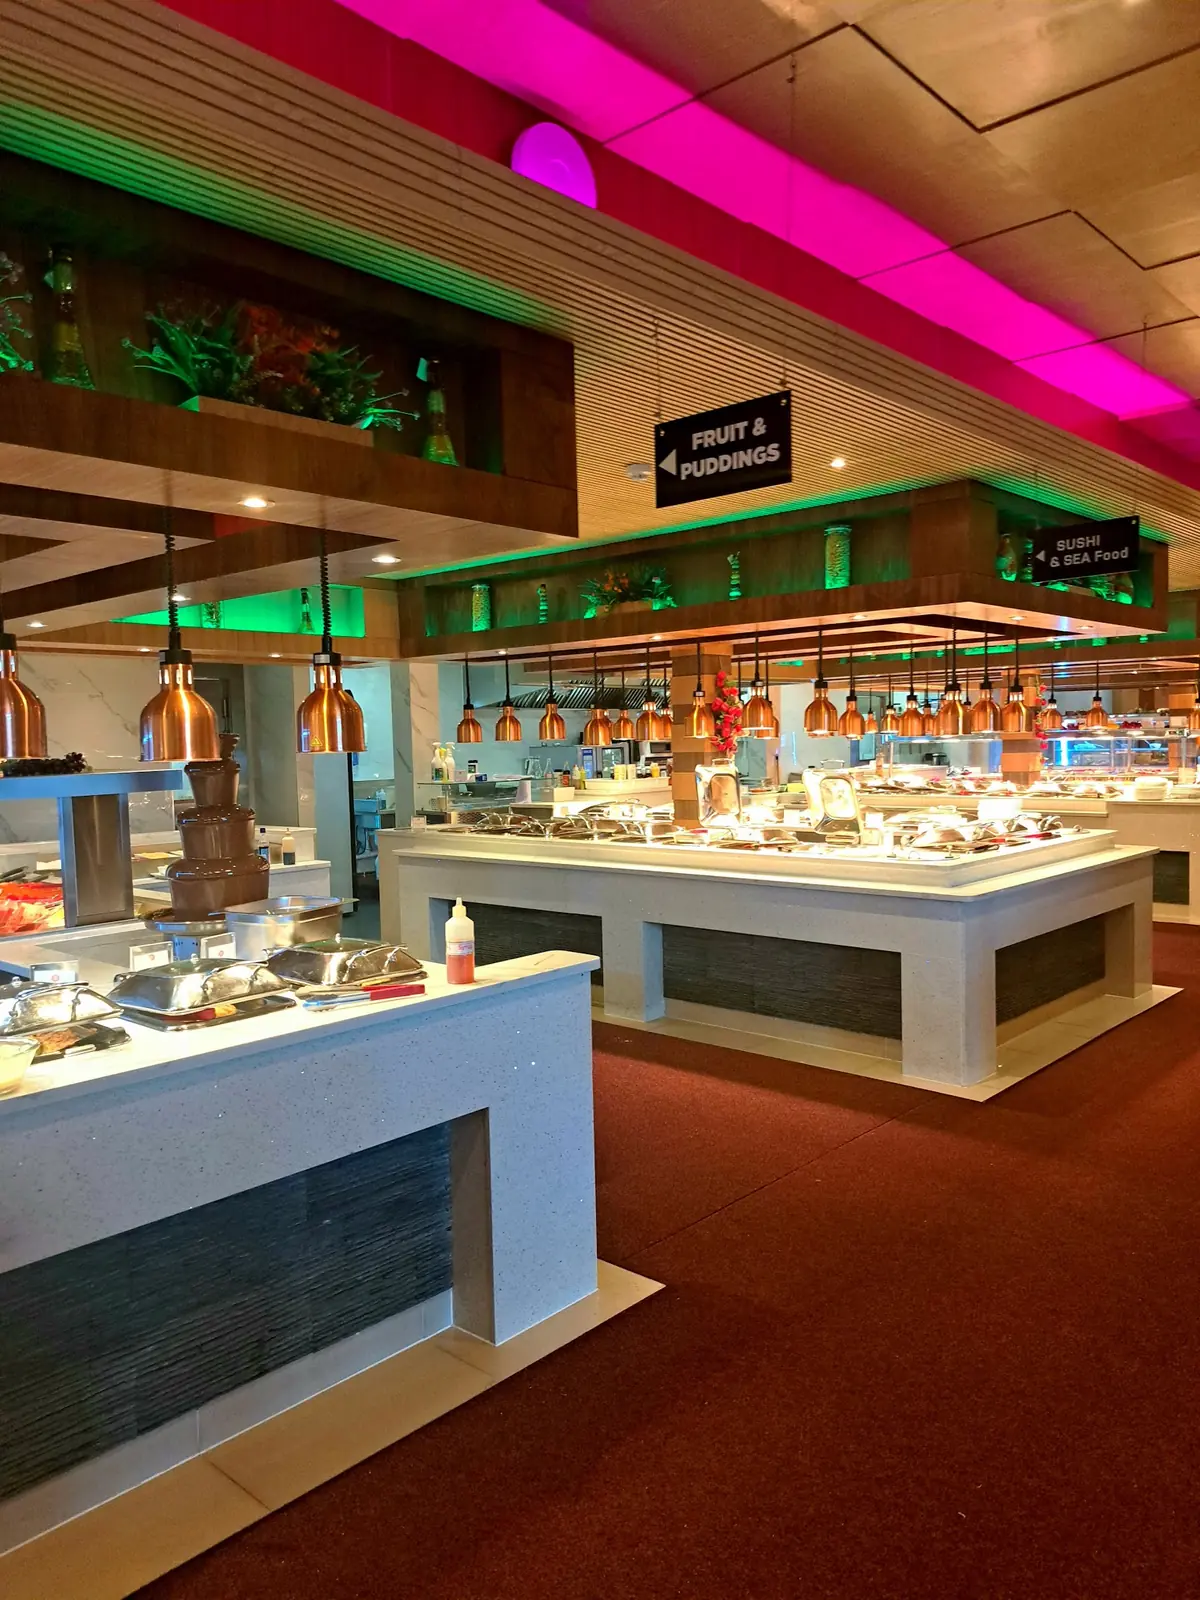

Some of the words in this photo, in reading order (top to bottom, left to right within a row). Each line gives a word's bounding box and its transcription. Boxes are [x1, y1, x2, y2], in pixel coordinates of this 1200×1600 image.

[691, 420, 749, 451] FRUIT
[752, 417, 767, 437] &
[680, 443, 781, 481] PUDDINGS
[1056, 535, 1101, 551] SUSHI
[1049, 556, 1060, 568] &
[1063, 552, 1091, 566] SEA
[1094, 547, 1129, 562] Food
